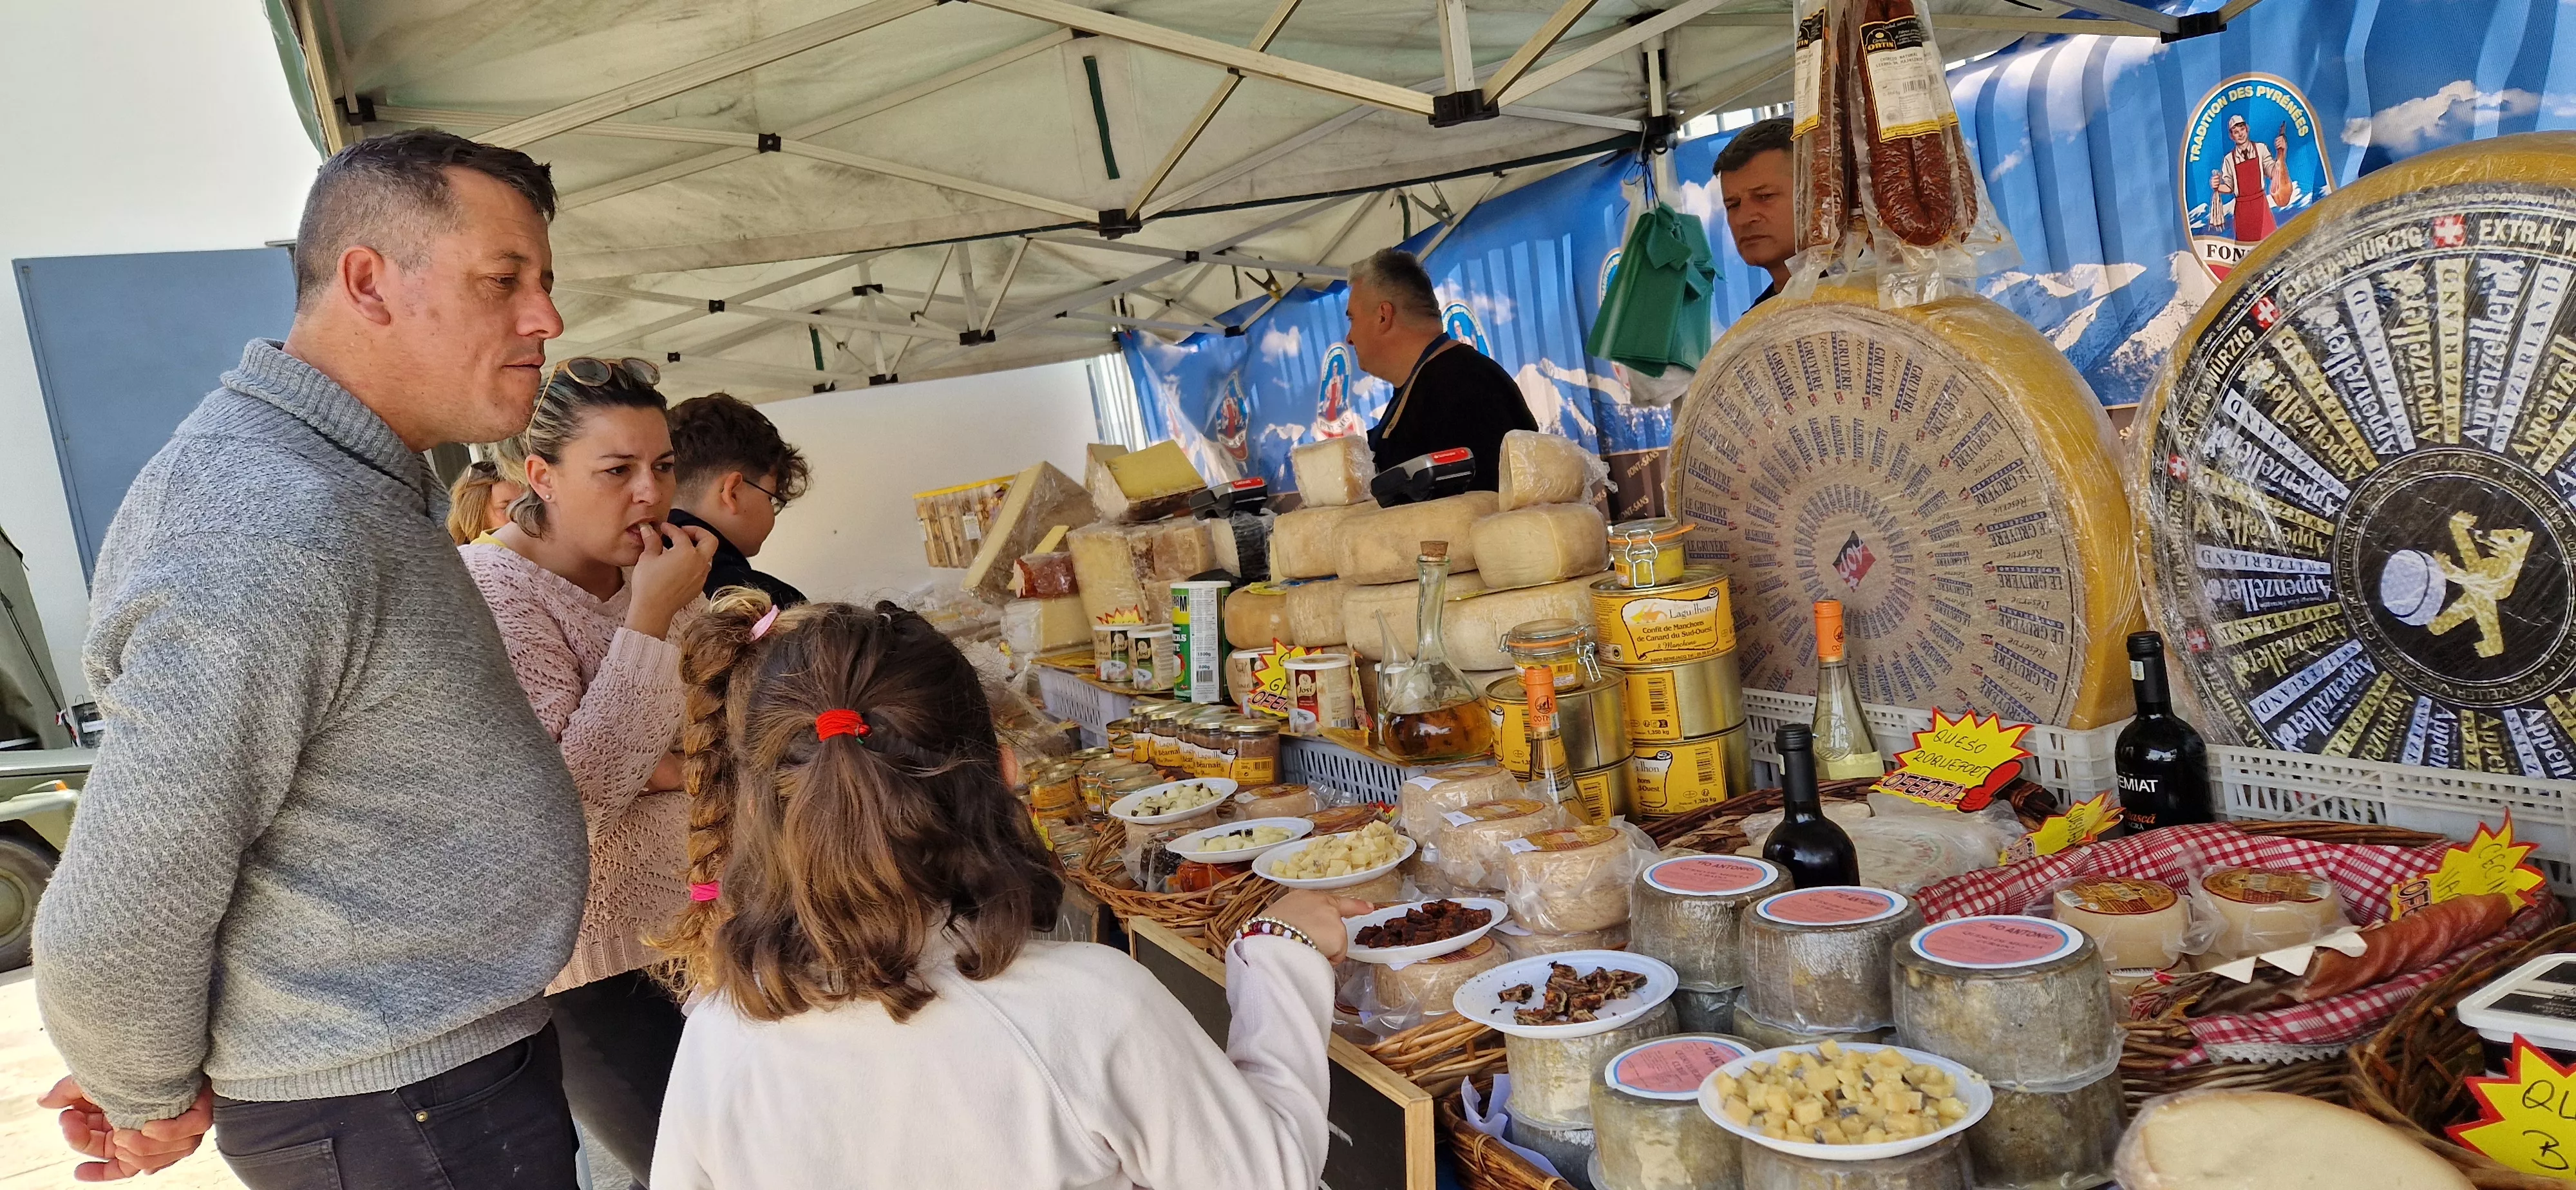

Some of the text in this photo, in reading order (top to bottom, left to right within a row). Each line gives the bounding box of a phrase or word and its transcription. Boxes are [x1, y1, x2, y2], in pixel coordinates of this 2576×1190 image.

[2190, 85, 2309, 162] TRADITION DES PYRÉNÉES
[2206, 243, 2250, 263] FON
[1803, 341, 1824, 392] GRUYÈRE
[1819, 336, 1832, 377] Réserve
[1837, 339, 1853, 392] GRUYÈRE
[1857, 339, 1865, 380] Réserve
[1771, 351, 1798, 400] GRUYÈRE
[1871, 346, 1886, 400] GRUYÈRE
[1888, 350, 1903, 392] Réserve
[1900, 364, 1924, 416] GRUYÈRE
[1953, 417, 2004, 472] LE GRUYÈRE
[1627, 451, 1660, 478] FONT-SANS
[1689, 456, 1732, 488] LE GRUYÈRE
[1974, 449, 2005, 477] Réserve
[2448, 455, 2486, 471] KÄSE
[1973, 466, 2033, 508] LE GRUYÈRE
[1685, 497, 1727, 519] LE GRUYÈRE
[1687, 538, 1729, 552] LE GRUYÈRE
[1989, 523, 2038, 548] GRUYÈRE
[2006, 549, 2043, 560] Réserve
[2201, 549, 2326, 572] SWITZERLAND
[1997, 574, 2063, 592] LE GRUYÈRE
[2219, 574, 2333, 612] Appenzeller
[2011, 596, 2049, 611] Réserve
[1642, 626, 1662, 634] Confit
[1674, 620, 1705, 631] Manchons
[1645, 633, 1670, 642] Canard
[1681, 626, 1712, 638] Sud-Ouest
[1998, 613, 2065, 645] LE GRUYÈRE
[1663, 639, 1698, 650] Manchons
[2007, 638, 2047, 660] Réserve
[1991, 648, 2041, 686] GRUYÈRE
[2260, 645, 2358, 713] SWITZERLAND
[1997, 675, 2036, 703] Réserve
[1933, 729, 1988, 754] QUESO
[1912, 750, 1993, 779] ROQUEFORT
[1880, 771, 1966, 804] OFERTA
[2117, 774, 2159, 793] EMIAT
[1712, 864, 1754, 872] ANTONIO
[2479, 843, 2509, 894] CECIN
[2006, 927, 2054, 940] ANTONIO
